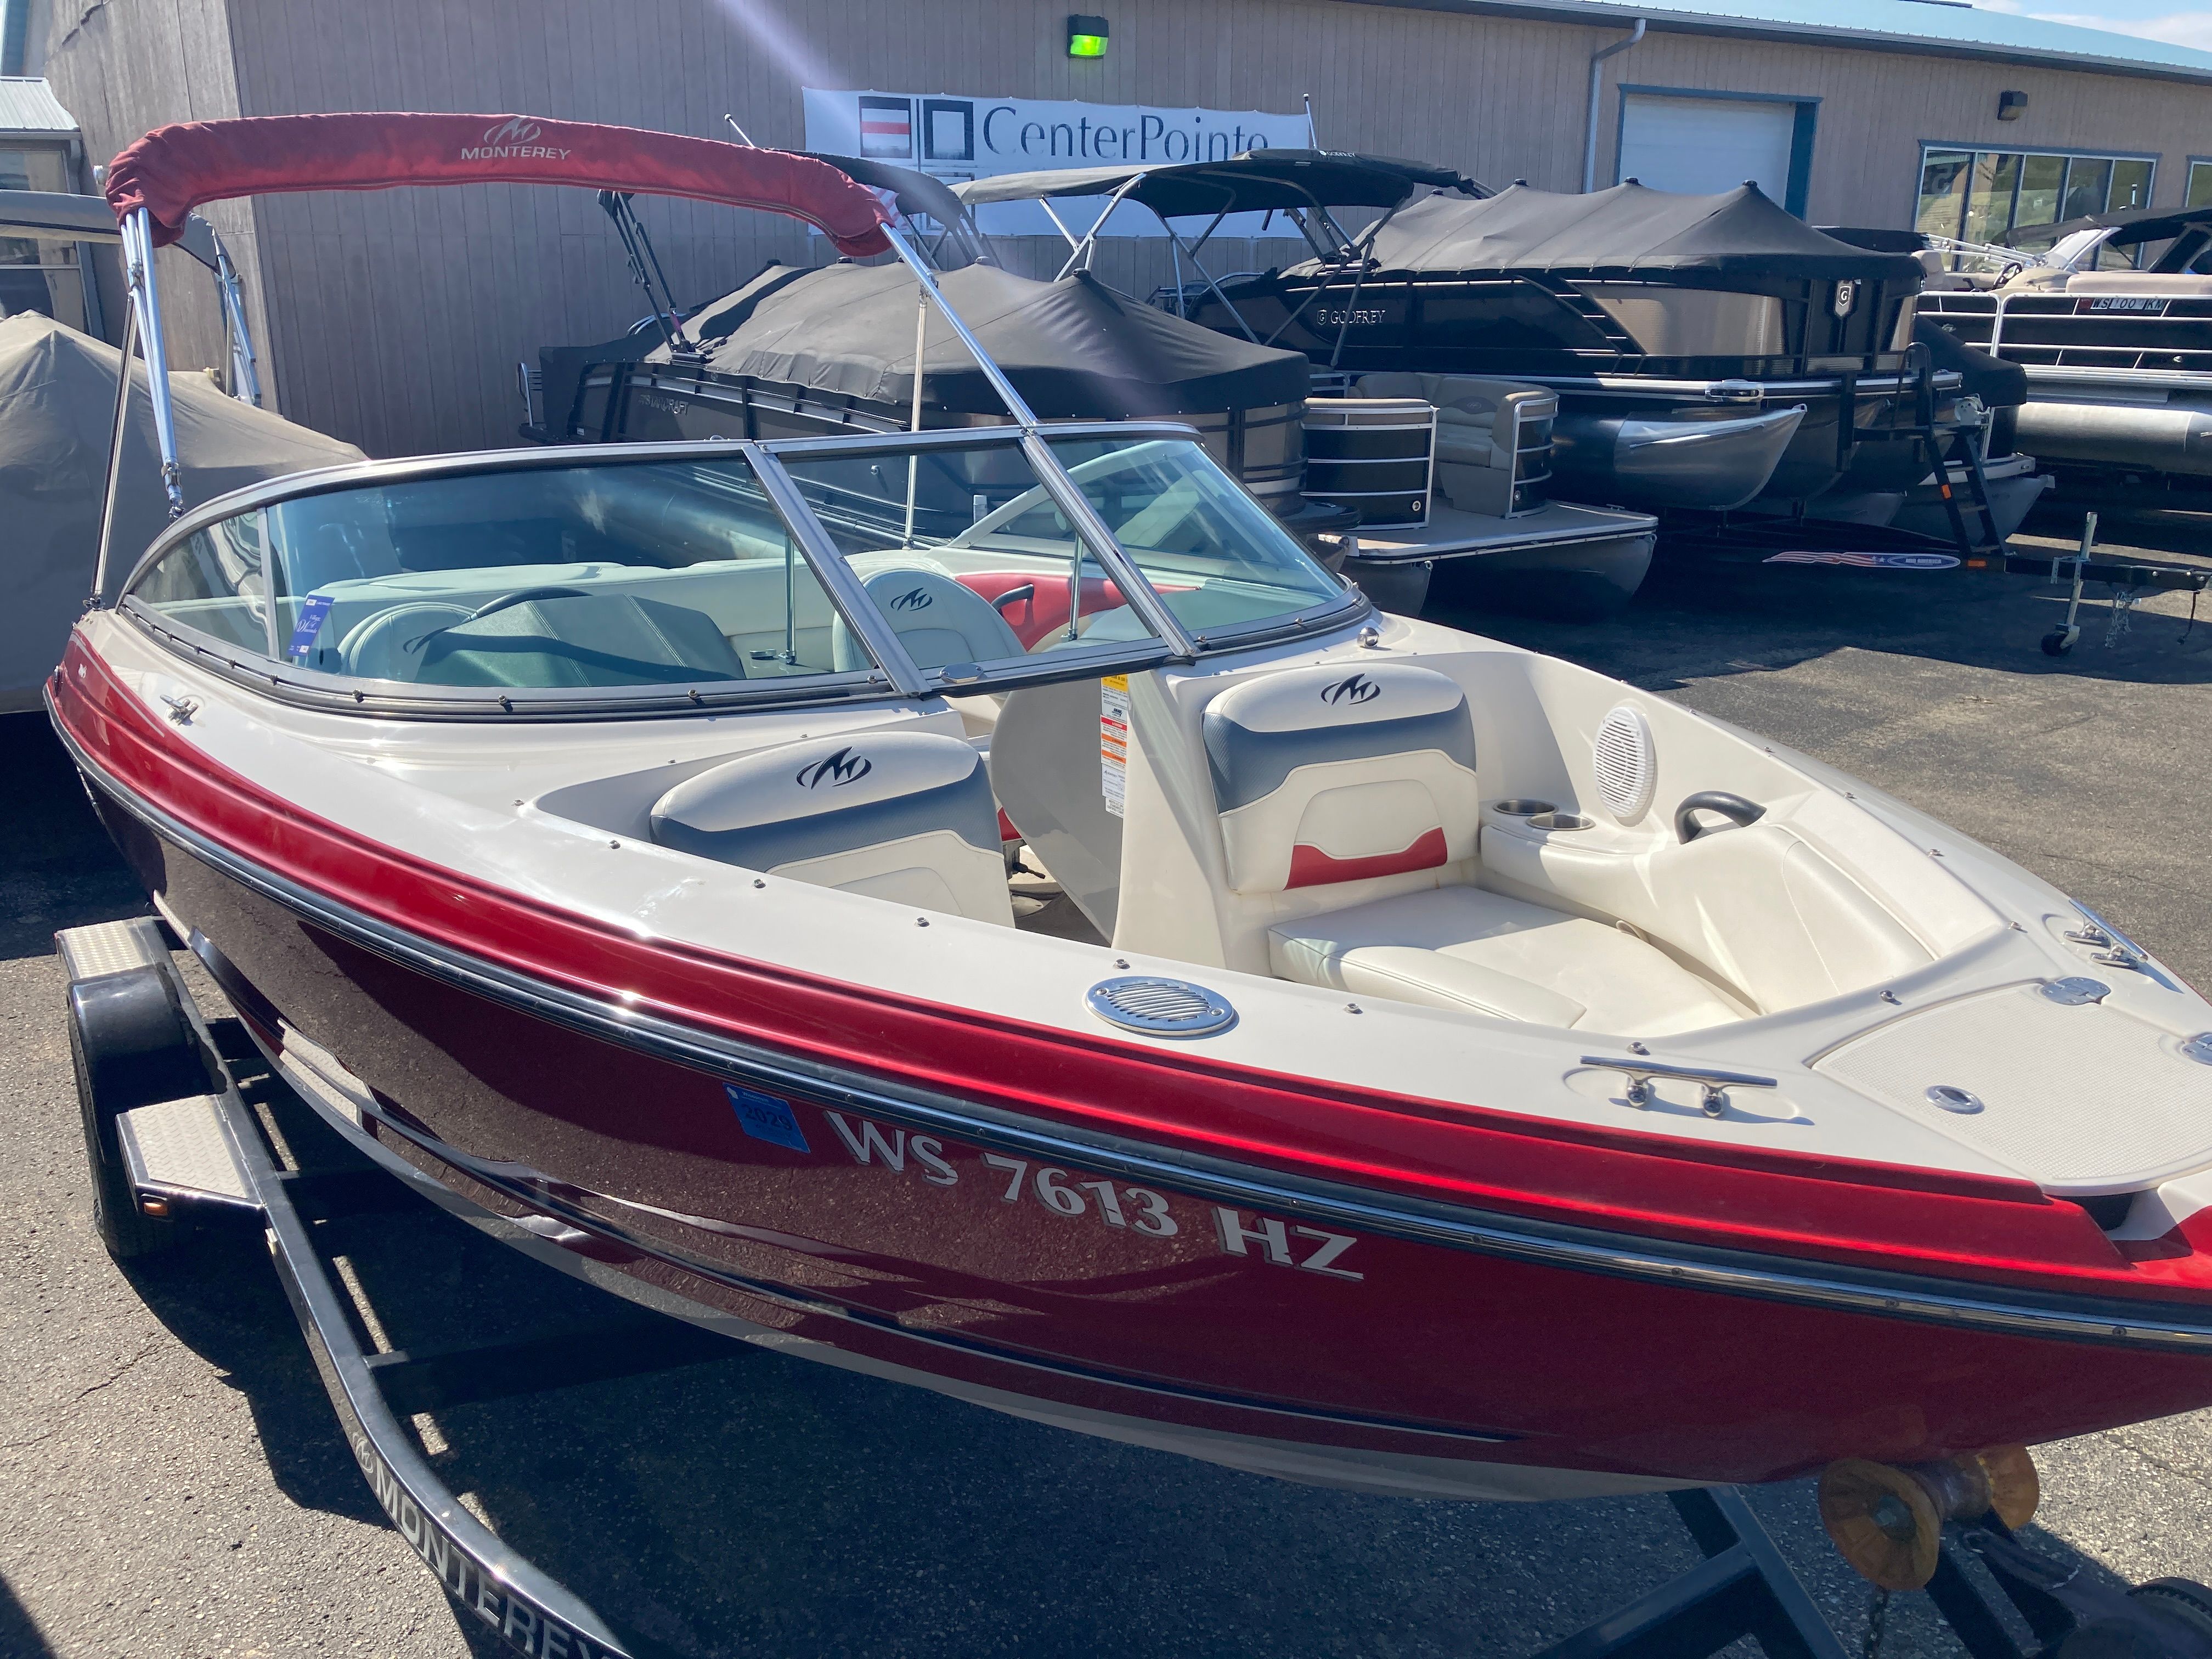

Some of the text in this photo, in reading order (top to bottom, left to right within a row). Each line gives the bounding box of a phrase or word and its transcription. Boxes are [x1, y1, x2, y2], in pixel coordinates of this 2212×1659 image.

[461, 145, 572, 160] MONTEREY
[2093, 298, 2109, 308] WS
[1330, 310, 1386, 324] GODFREY
[825, 1109, 1364, 1282] WS 7613 HZ
